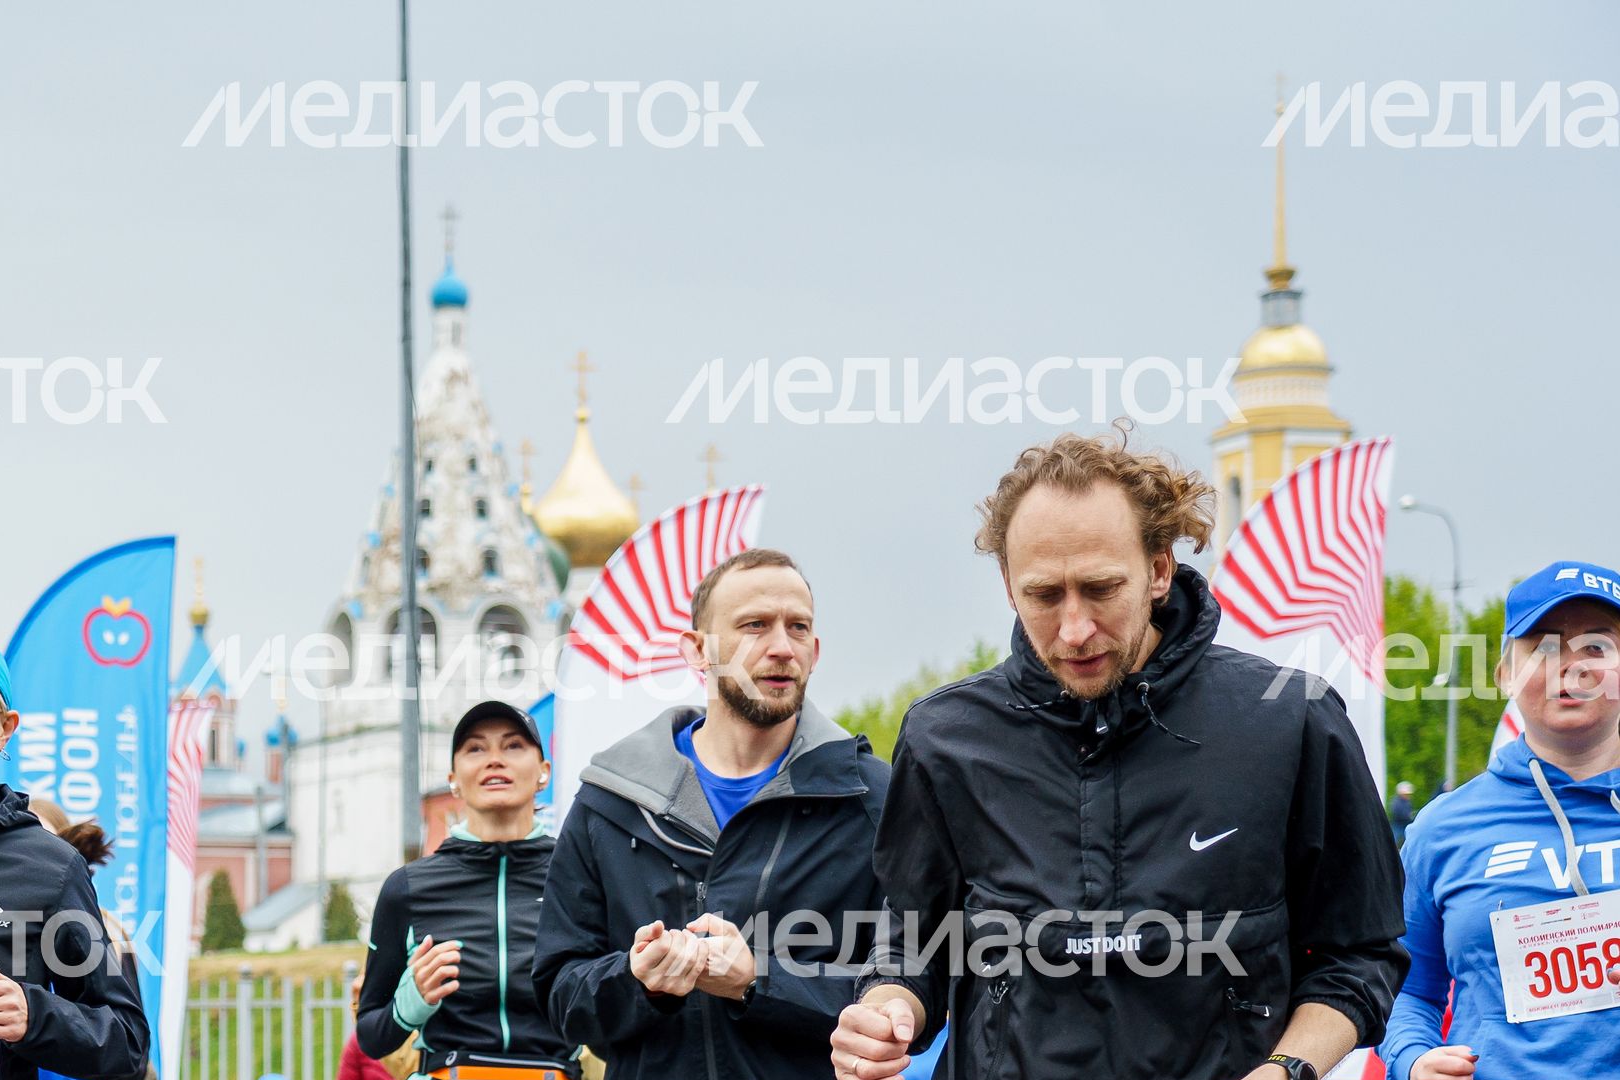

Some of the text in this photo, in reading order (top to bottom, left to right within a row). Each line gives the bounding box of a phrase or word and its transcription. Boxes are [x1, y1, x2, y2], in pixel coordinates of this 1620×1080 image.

[1065, 934, 1142, 954] JUST DO IT
